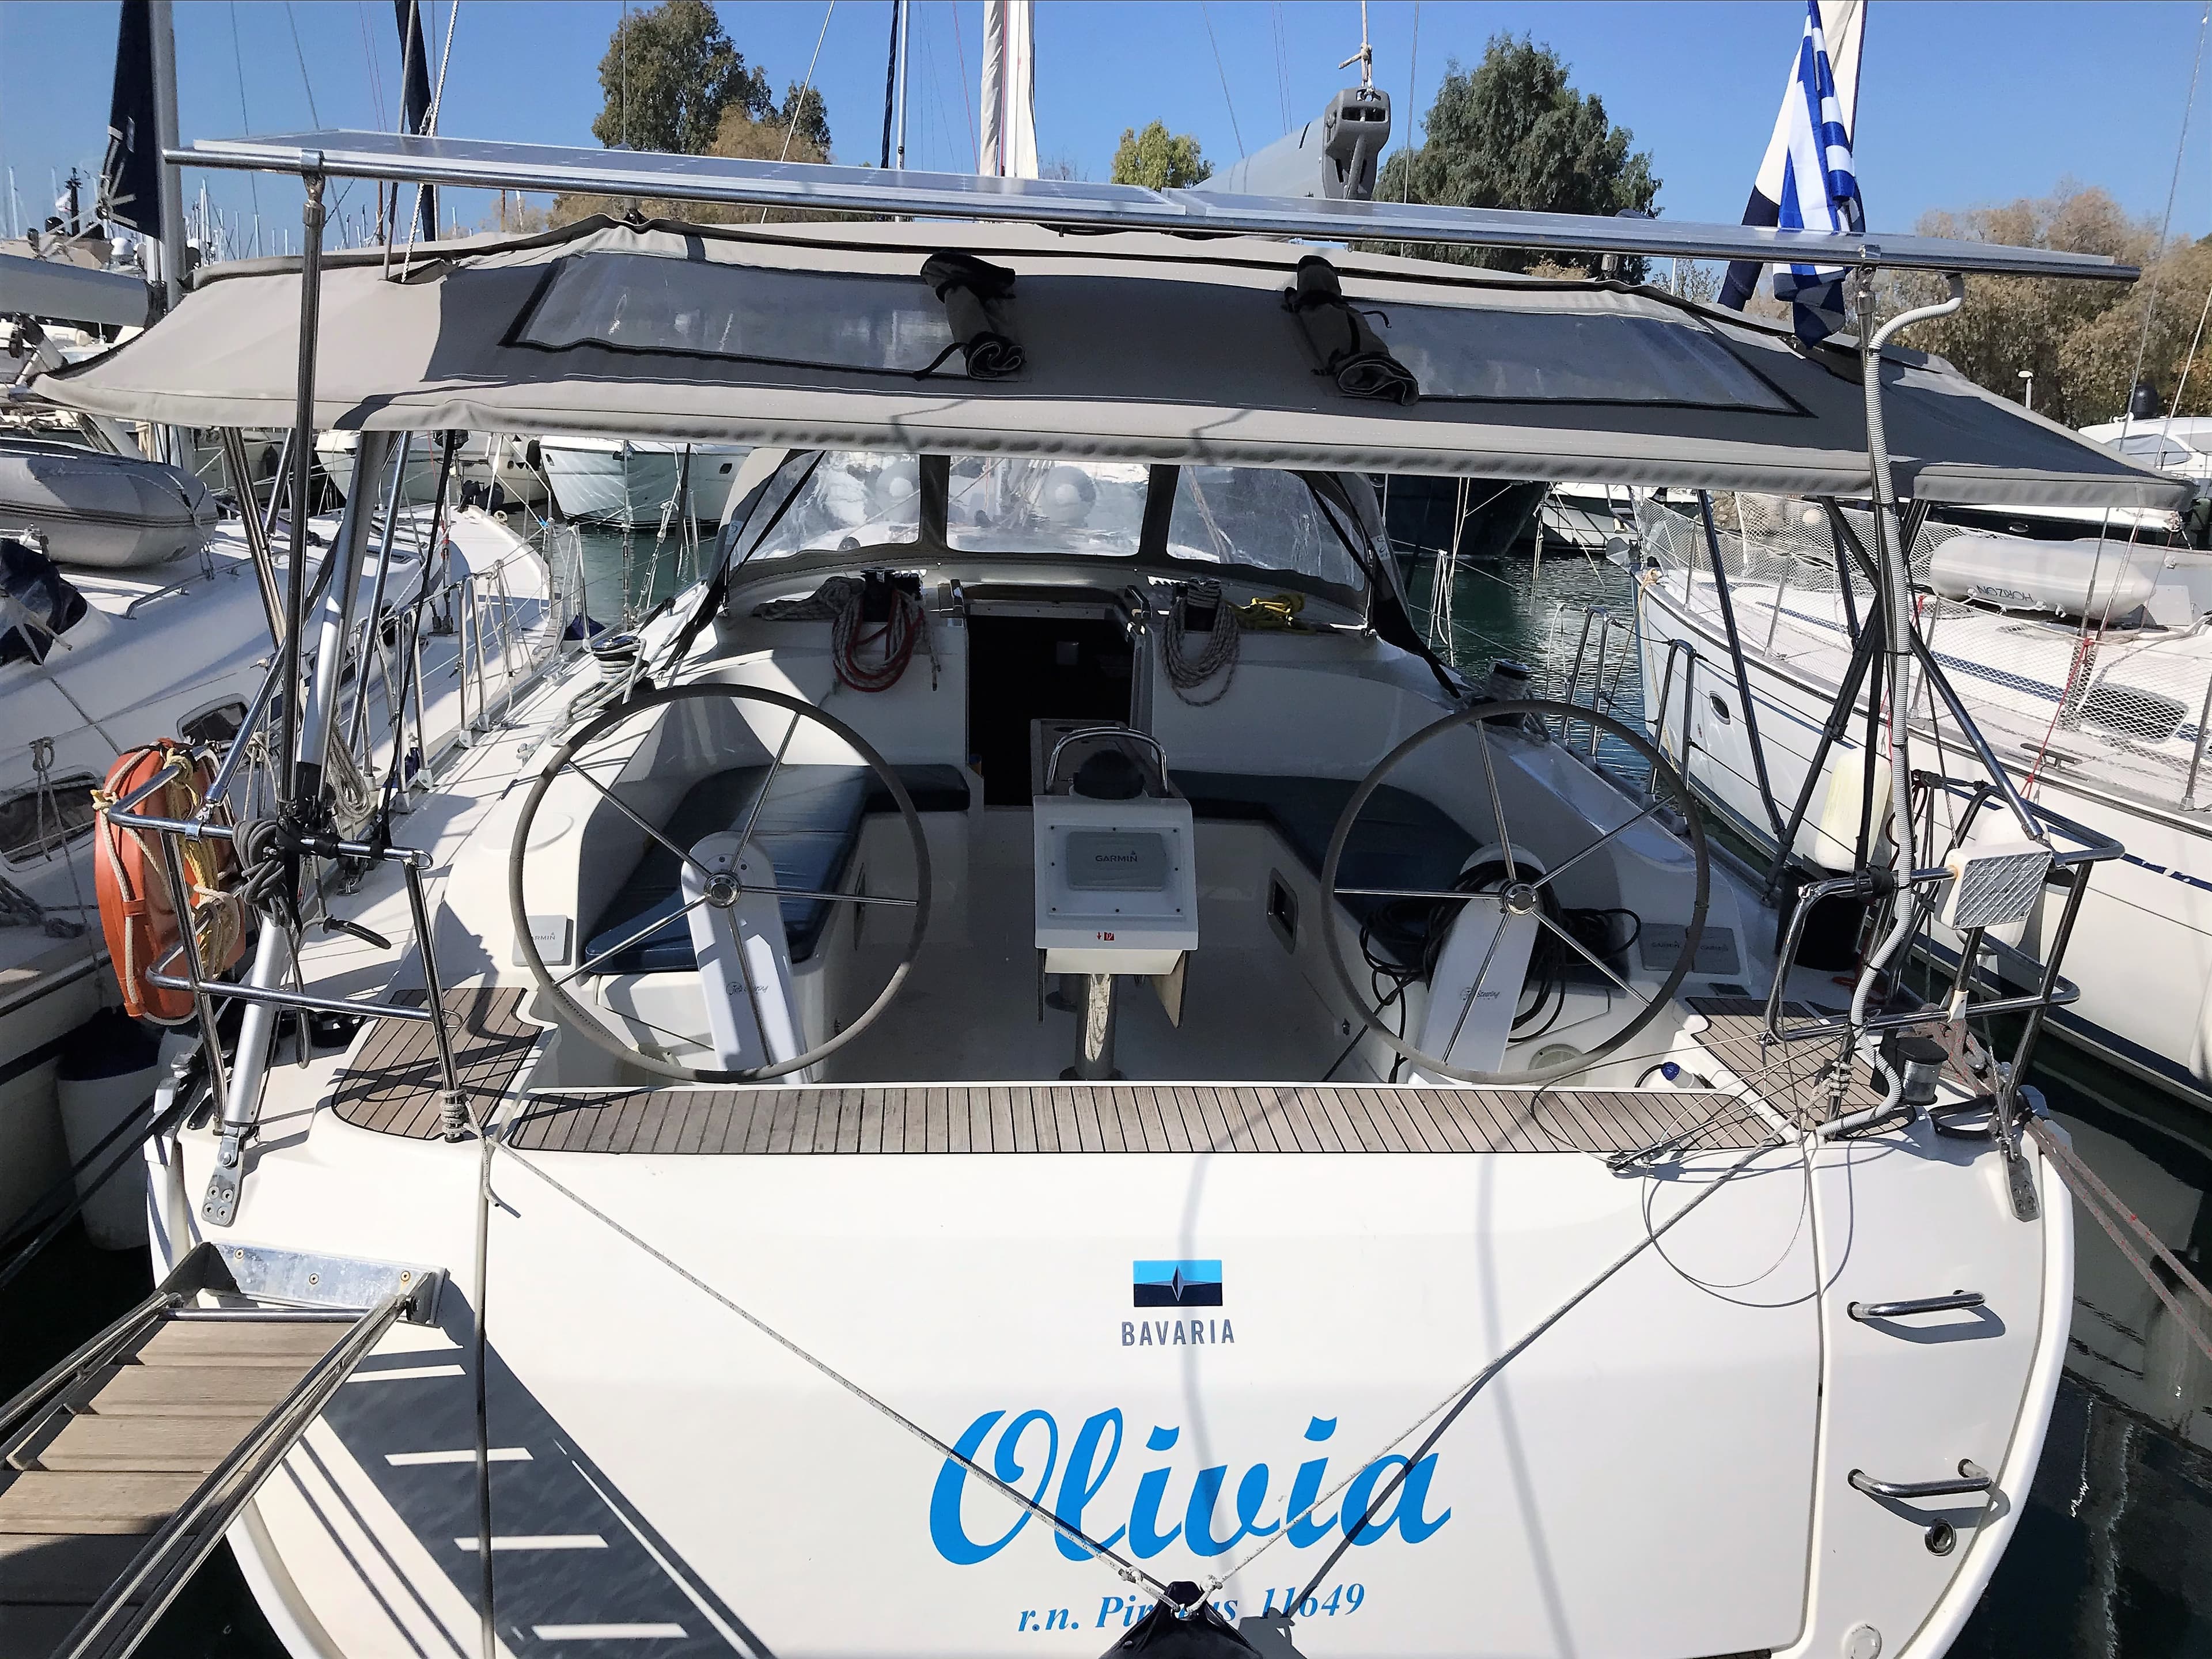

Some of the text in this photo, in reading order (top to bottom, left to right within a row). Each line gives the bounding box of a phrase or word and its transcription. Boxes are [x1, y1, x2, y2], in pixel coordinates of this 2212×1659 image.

[1976, 585, 2033, 602] HORIZON
[1095, 854, 1138, 862] GARMIN
[1122, 1319, 1235, 1346] BAVARIA
[929, 1407, 1452, 1565] Olivia
[1018, 1583, 1365, 1632] r.n. Pirs 11649
